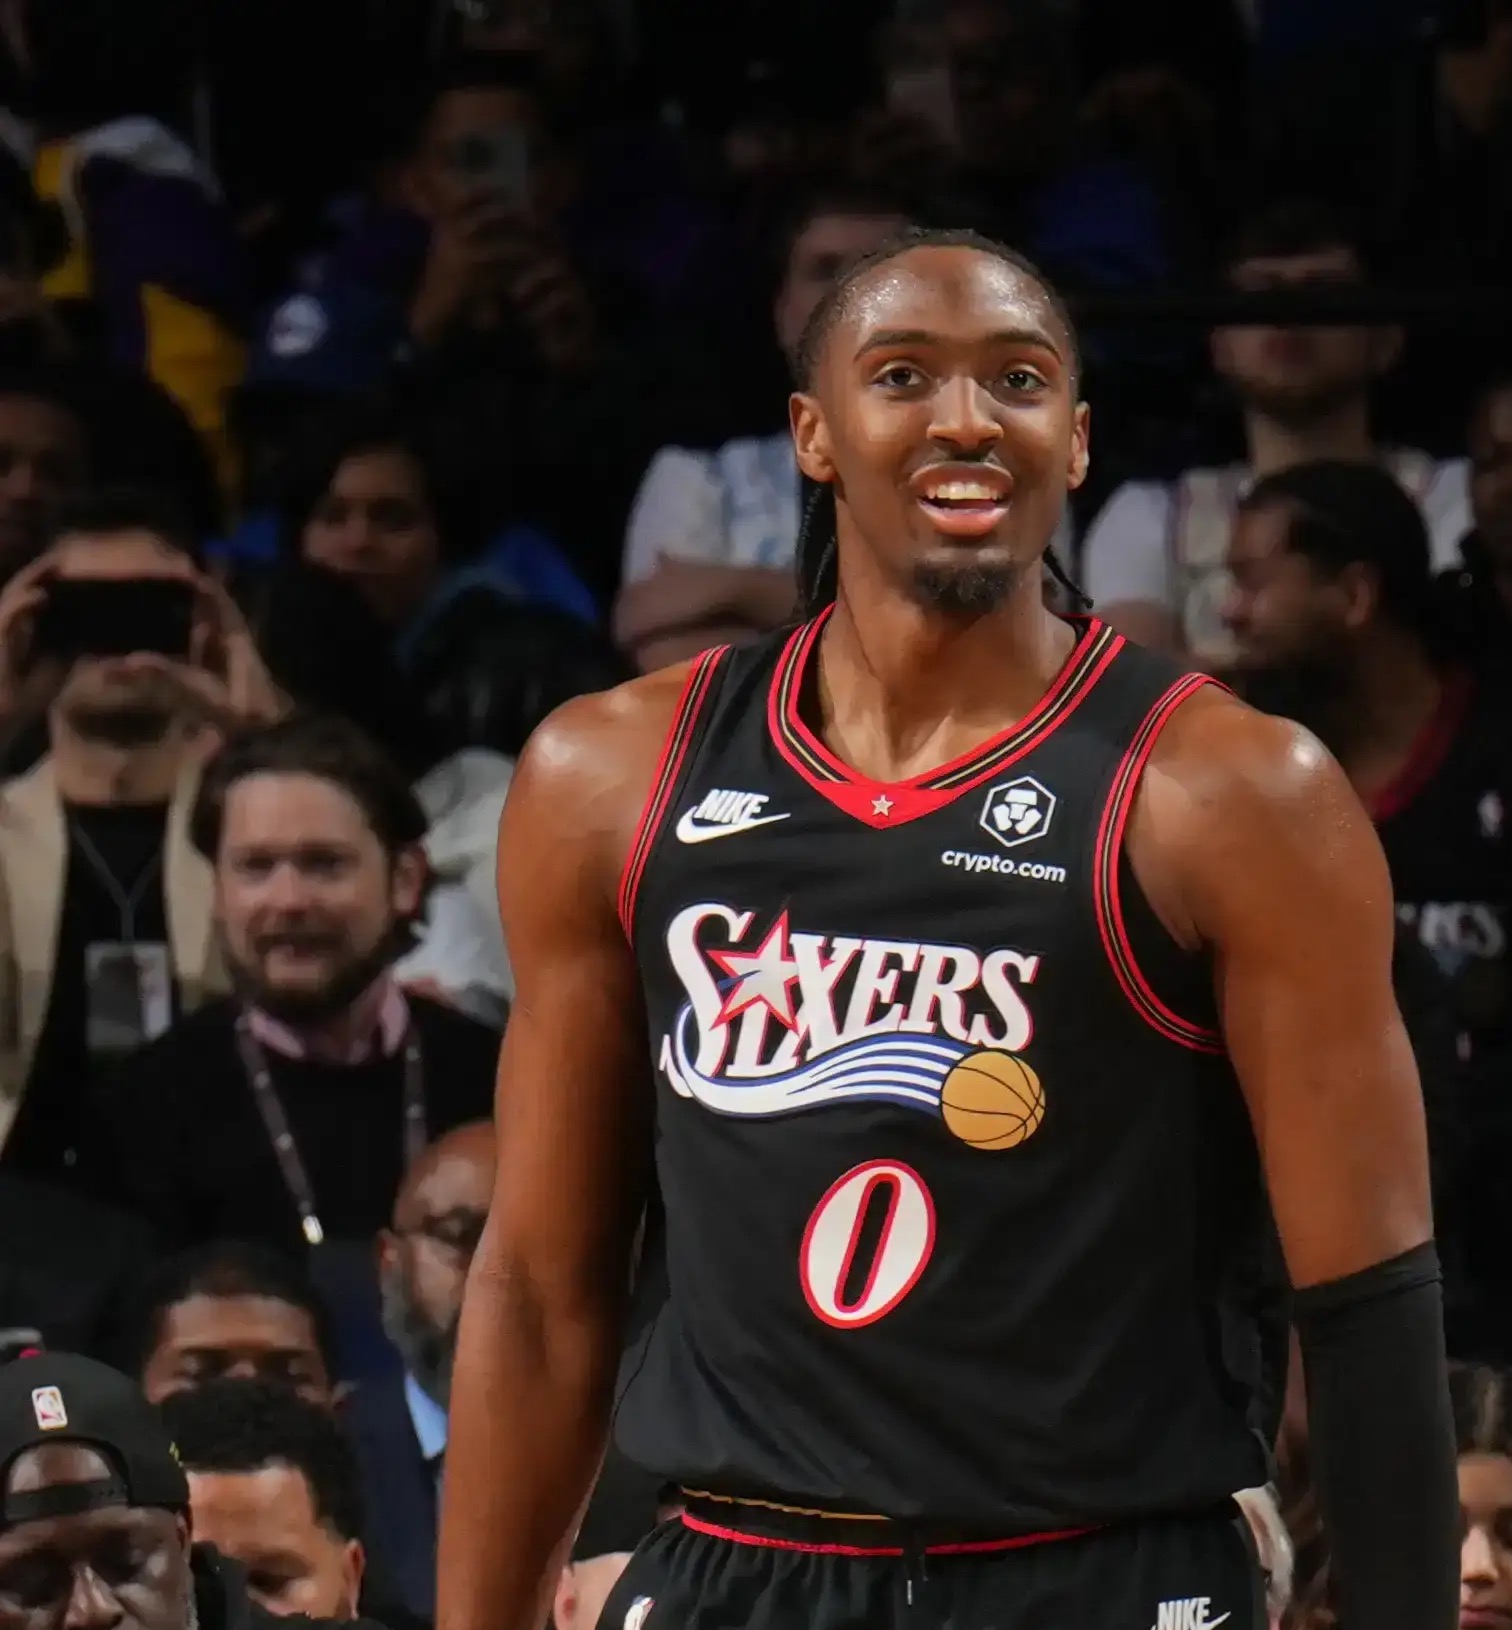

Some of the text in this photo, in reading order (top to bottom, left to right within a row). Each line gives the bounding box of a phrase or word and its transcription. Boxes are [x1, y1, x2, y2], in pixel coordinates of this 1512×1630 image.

[693, 788, 770, 824] NIKE
[941, 850, 1067, 883] crypto.com
[659, 901, 1042, 1098] SIXERS
[799, 1158, 938, 1329] 0
